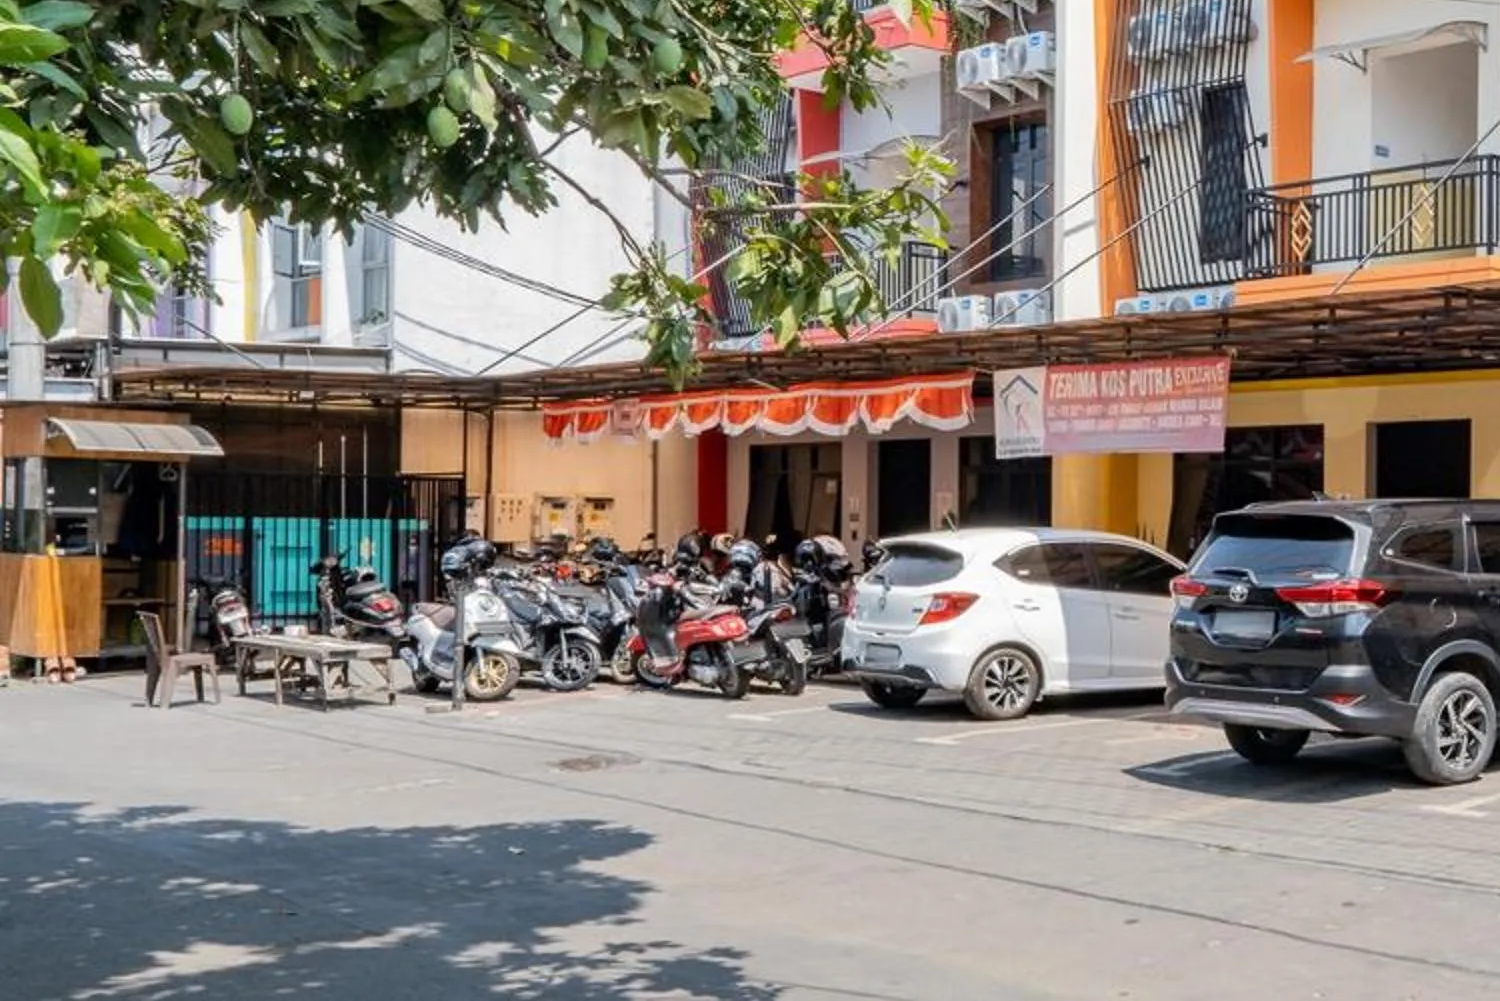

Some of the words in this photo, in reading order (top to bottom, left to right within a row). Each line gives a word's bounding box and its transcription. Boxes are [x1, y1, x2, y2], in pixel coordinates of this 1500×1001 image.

[1049, 370, 1098, 400] TERIMA
[1101, 369, 1126, 398] KOS
[1129, 366, 1173, 396] PUTRA
